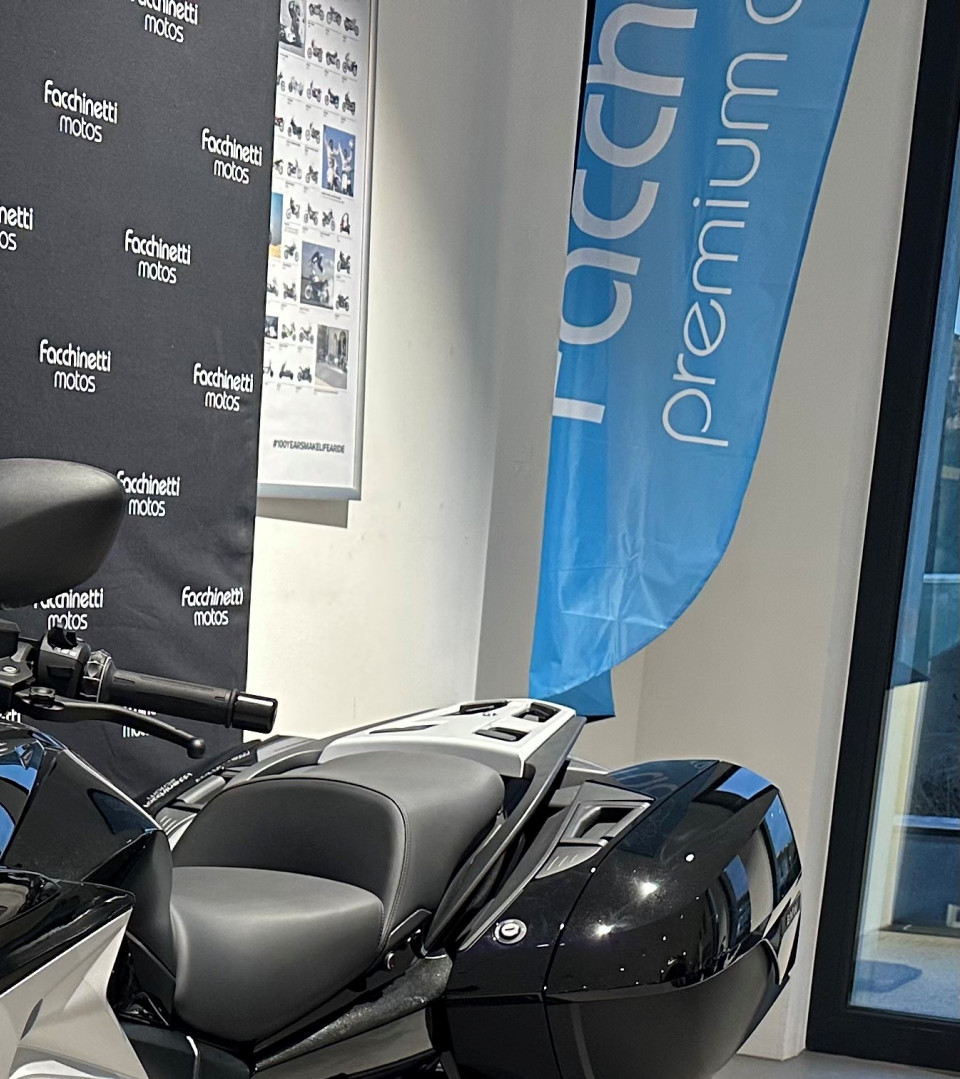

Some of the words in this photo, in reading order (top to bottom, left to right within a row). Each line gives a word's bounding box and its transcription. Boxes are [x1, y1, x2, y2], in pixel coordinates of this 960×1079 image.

[144, 14, 184, 42] motos
[44, 80, 118, 125] Facchinetti
[59, 115, 103, 143] motos
[202, 128, 263, 167] Facchinetti
[213, 160, 250, 185] motos
[125, 229, 191, 265] Facchinetti
[661, 53, 788, 448] premium
[138, 260, 177, 284] motos
[40, 338, 112, 373] Facchinetti
[54, 369, 96, 393] motos
[193, 362, 254, 394] Facchinetti
[204, 391, 241, 412] motos
[128, 496, 166, 517] motos
[181, 586, 244, 607] Facchinetti
[193, 610, 229, 627] motos
